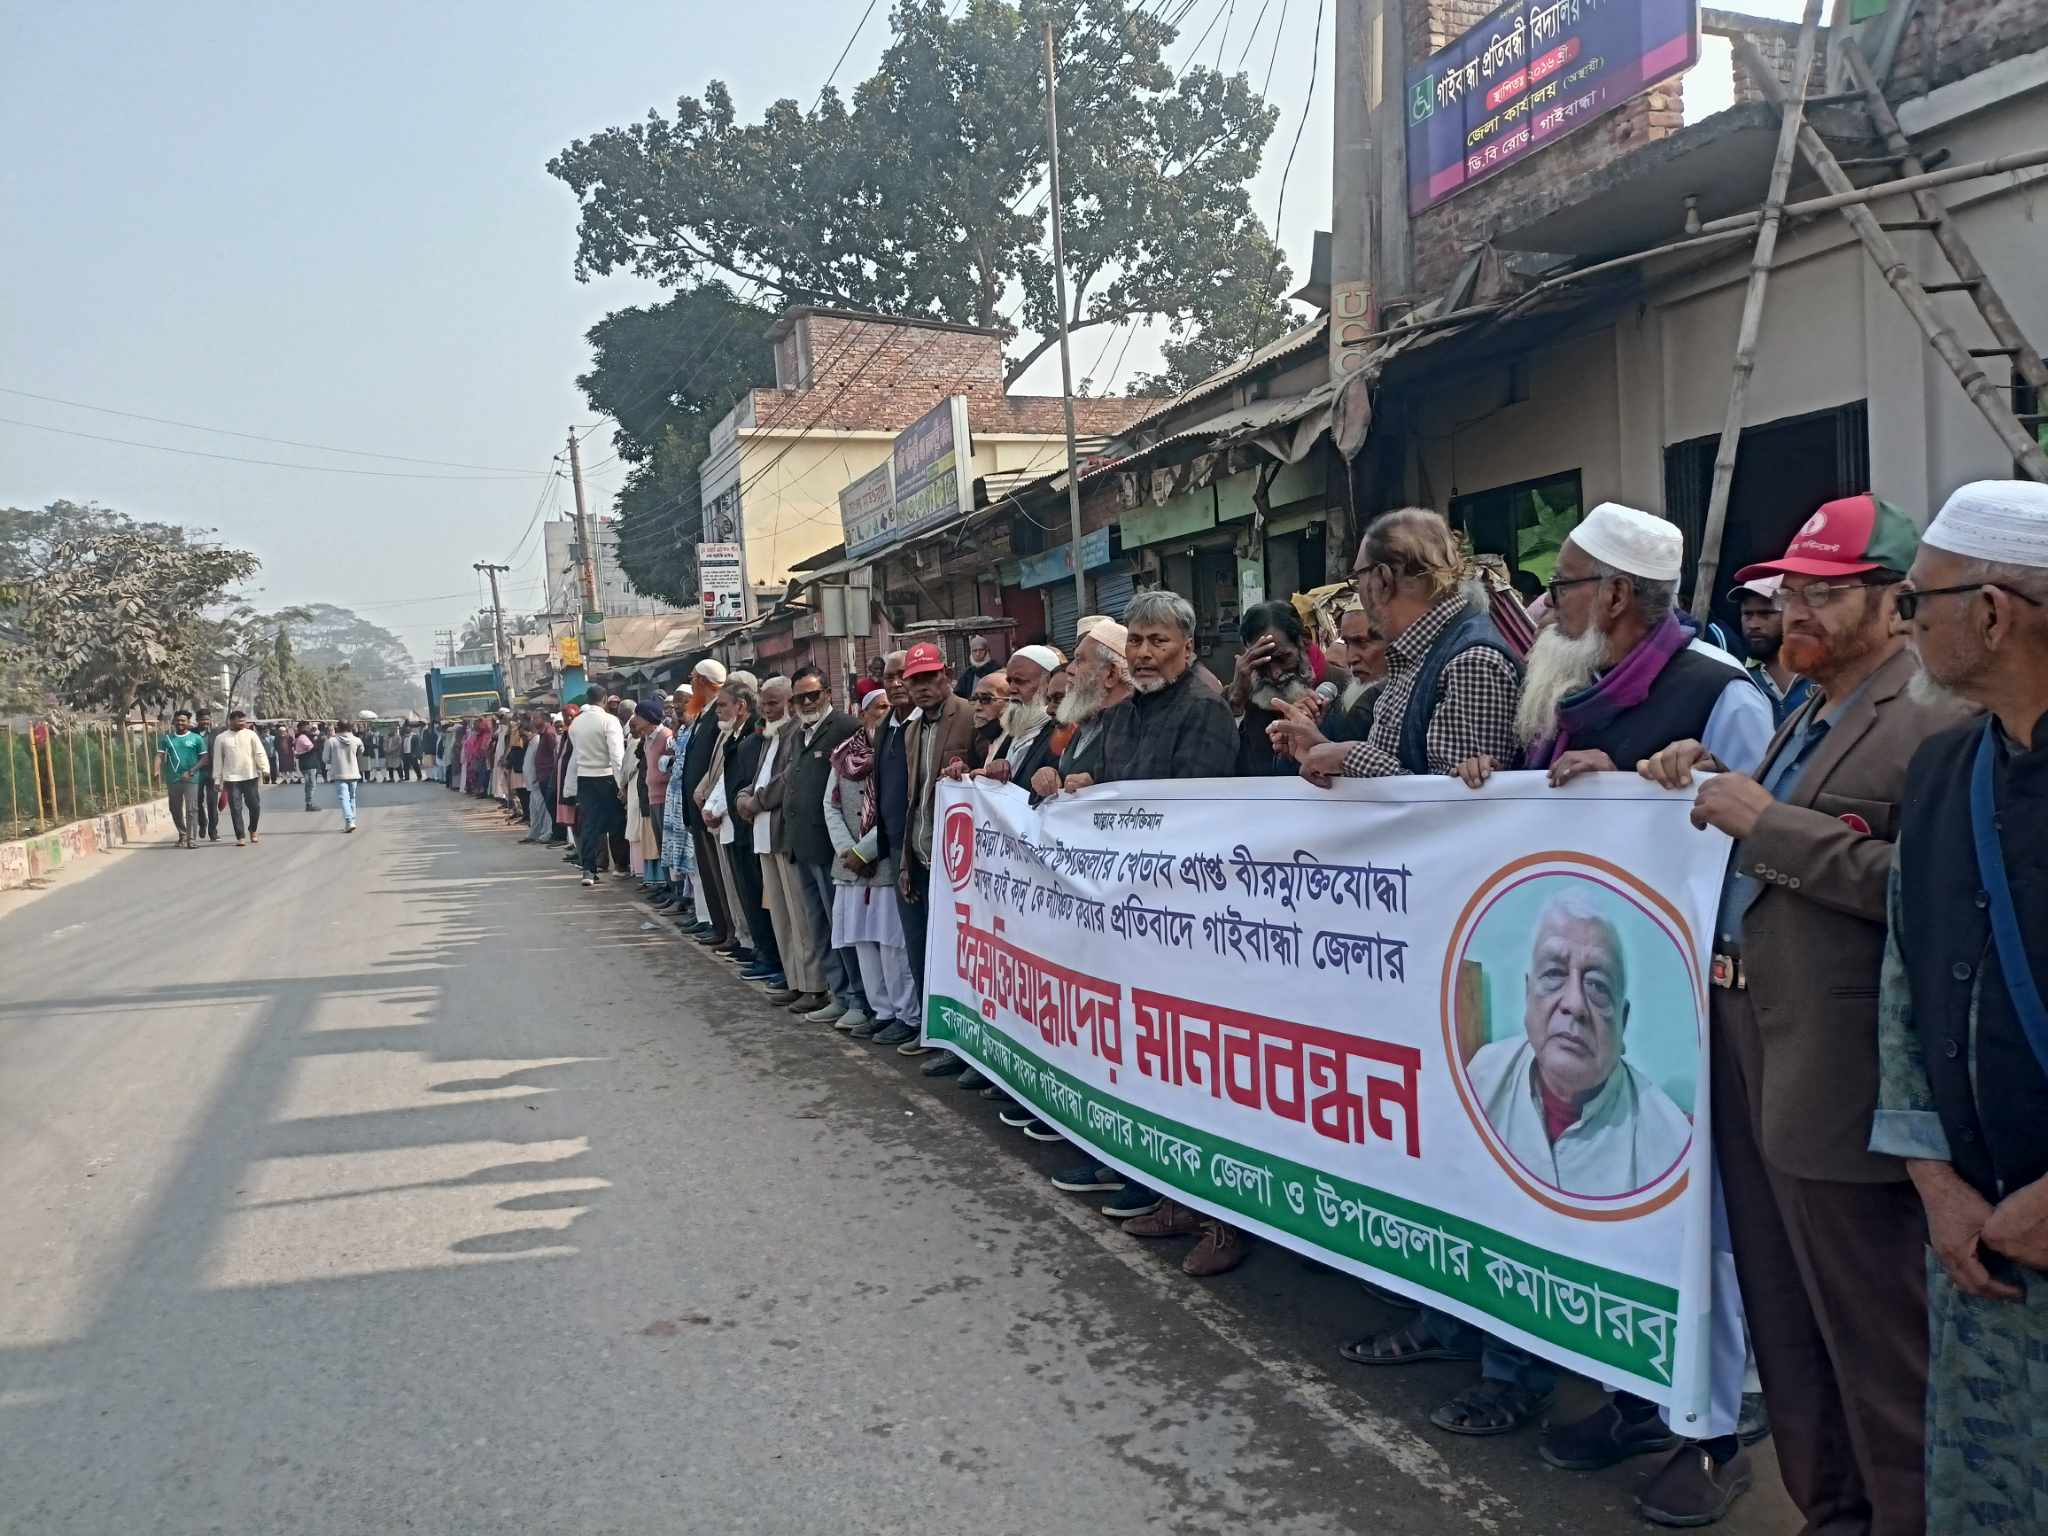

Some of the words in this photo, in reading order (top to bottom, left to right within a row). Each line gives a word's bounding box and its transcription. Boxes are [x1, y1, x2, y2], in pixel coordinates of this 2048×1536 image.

[1437, 56, 1479, 109] গাইবান্ধা
[1483, 16, 1527, 80] প্রতিবন্ধী
[1467, 116, 1500, 146] জেলা
[1503, 81, 1558, 122] কার্যালয়
[1539, 89, 1598, 130] গাইবান্ধা
[1093, 811, 1117, 831] আল্লাহ
[1118, 806, 1164, 831] সর্বশক্তিমান
[1052, 838, 1119, 882] উপজেলার
[1118, 848, 1176, 889] খেতাব
[1180, 851, 1224, 894] প্রাপ্ত
[1229, 843, 1412, 914] বীরমুক্তিযোদ্ধা
[994, 867, 1011, 904] হাই
[1031, 885, 1046, 912] কে
[1075, 896, 1107, 934] করার
[1111, 893, 1195, 949] প্রতিবাদে
[1202, 903, 1304, 967] গাইবান্ধা
[1312, 927, 1408, 983] জেলার
[1131, 987, 1422, 1158] মানববন্ধন
[1040, 1067, 1082, 1122] গাইবান্ধা
[1087, 1100, 1133, 1150] জেলার
[1136, 1121, 1202, 1177] সাবেক
[1211, 1152, 1273, 1208] জেলা
[1283, 1179, 1305, 1215] ও
[1314, 1174, 1473, 1282] উপজেলার
[1481, 1245, 1679, 1384] কমান্ডারবৃ
